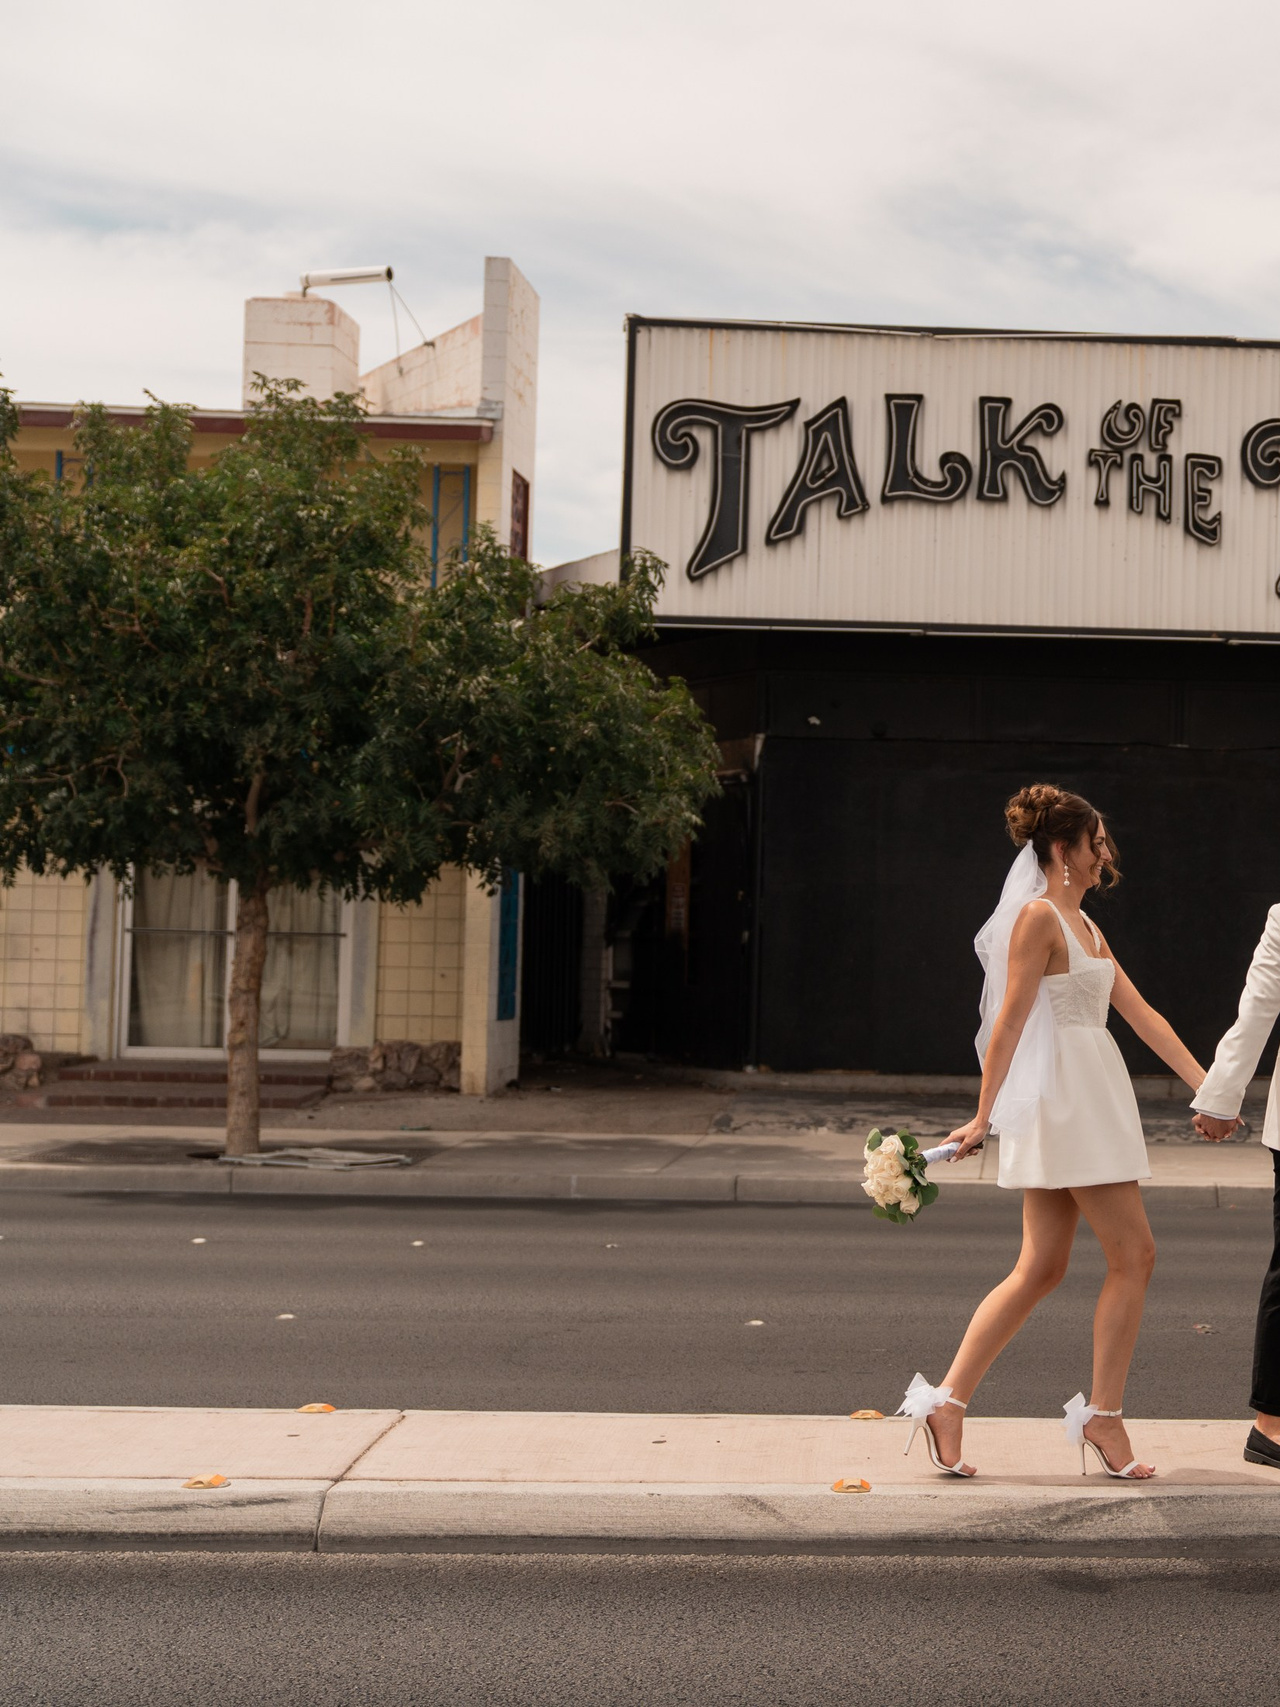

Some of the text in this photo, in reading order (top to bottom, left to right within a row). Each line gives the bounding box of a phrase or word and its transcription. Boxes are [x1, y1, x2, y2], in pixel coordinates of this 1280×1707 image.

[1101, 398, 1182, 452] OF
[652, 394, 1066, 582] TALK
[1088, 449, 1223, 547] THE
